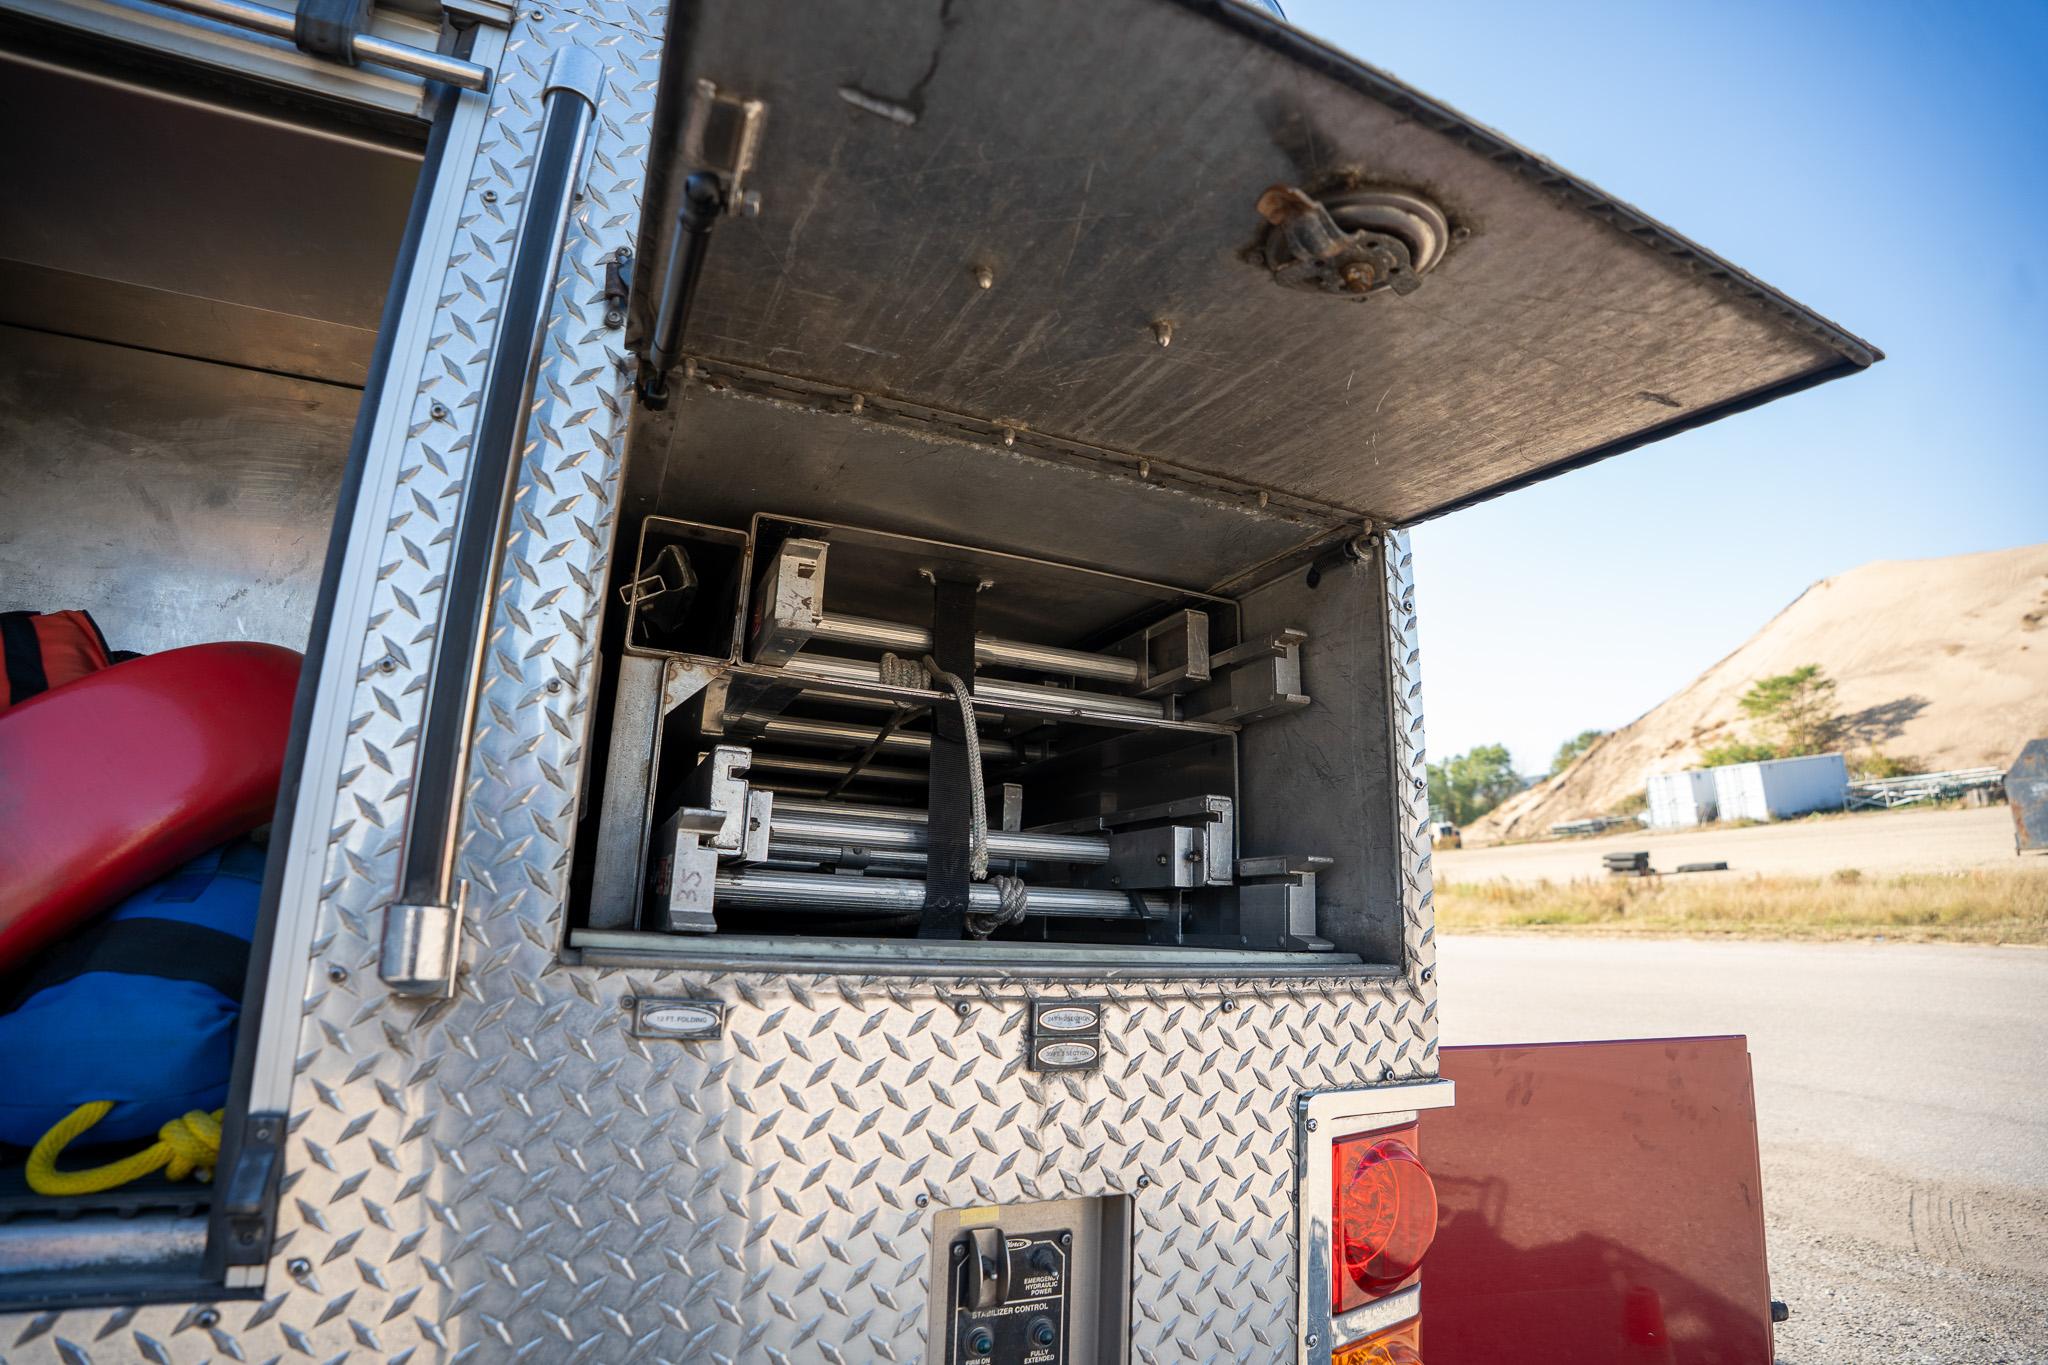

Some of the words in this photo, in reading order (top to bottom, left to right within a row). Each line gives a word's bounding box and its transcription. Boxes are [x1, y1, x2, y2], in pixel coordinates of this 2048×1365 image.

[677, 1016, 707, 1024] FOLDING
[1025, 1281, 1058, 1291] HYDRAULIC
[1031, 1288, 1052, 1296] POWER
[972, 1307, 1013, 1319] STABILIZER
[1014, 1302, 1048, 1314] CONTROL
[1030, 1349, 1049, 1357] FULLY
[1024, 1354, 1055, 1365] EXTENDED
